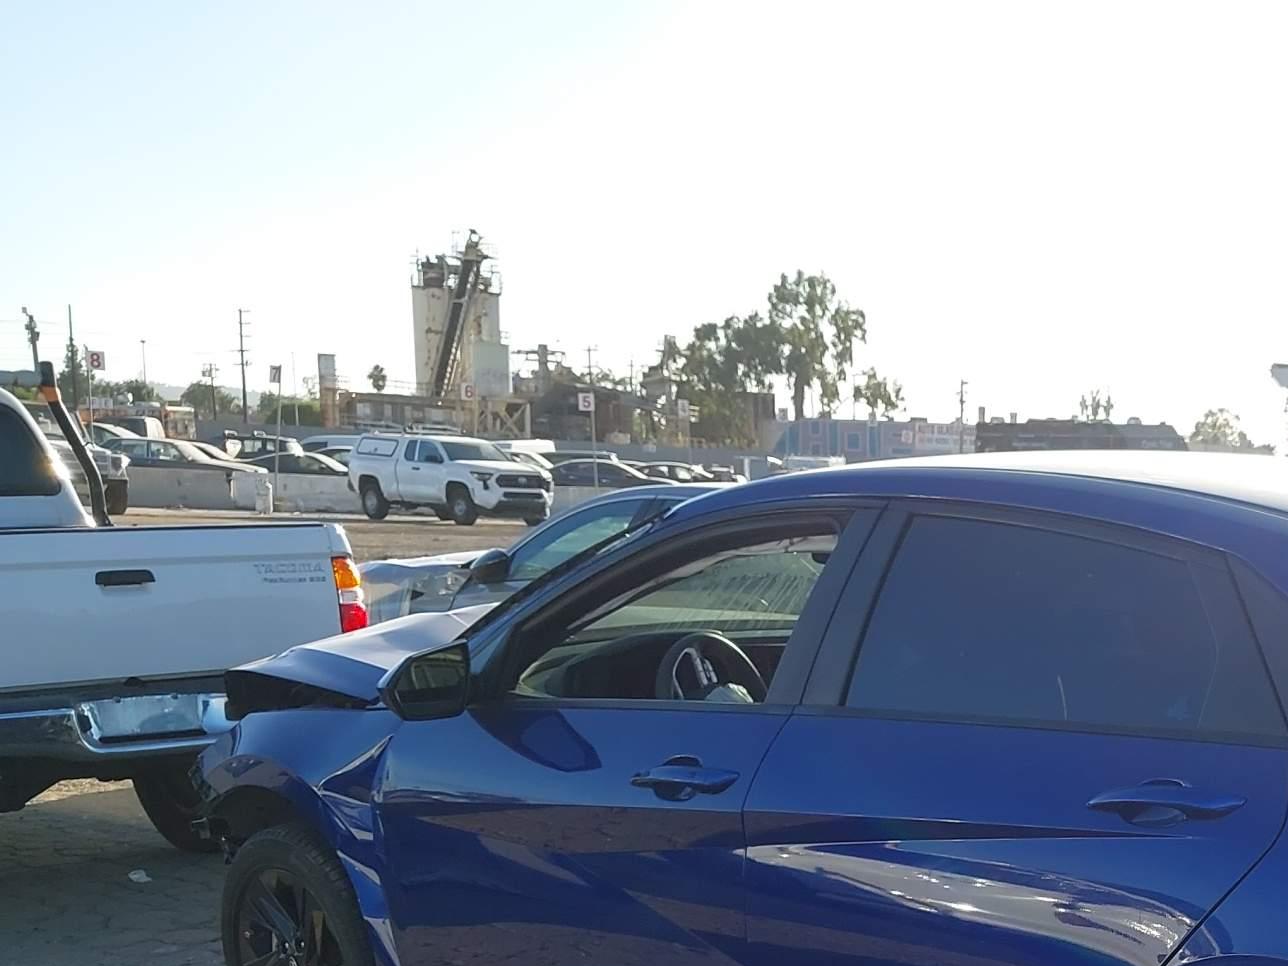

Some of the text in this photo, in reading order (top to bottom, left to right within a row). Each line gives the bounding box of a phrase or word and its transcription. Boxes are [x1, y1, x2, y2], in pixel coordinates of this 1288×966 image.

[90, 352, 101, 368] 8
[271, 366, 279, 382] 7
[464, 384, 473, 399] 6
[583, 394, 592, 409] 5
